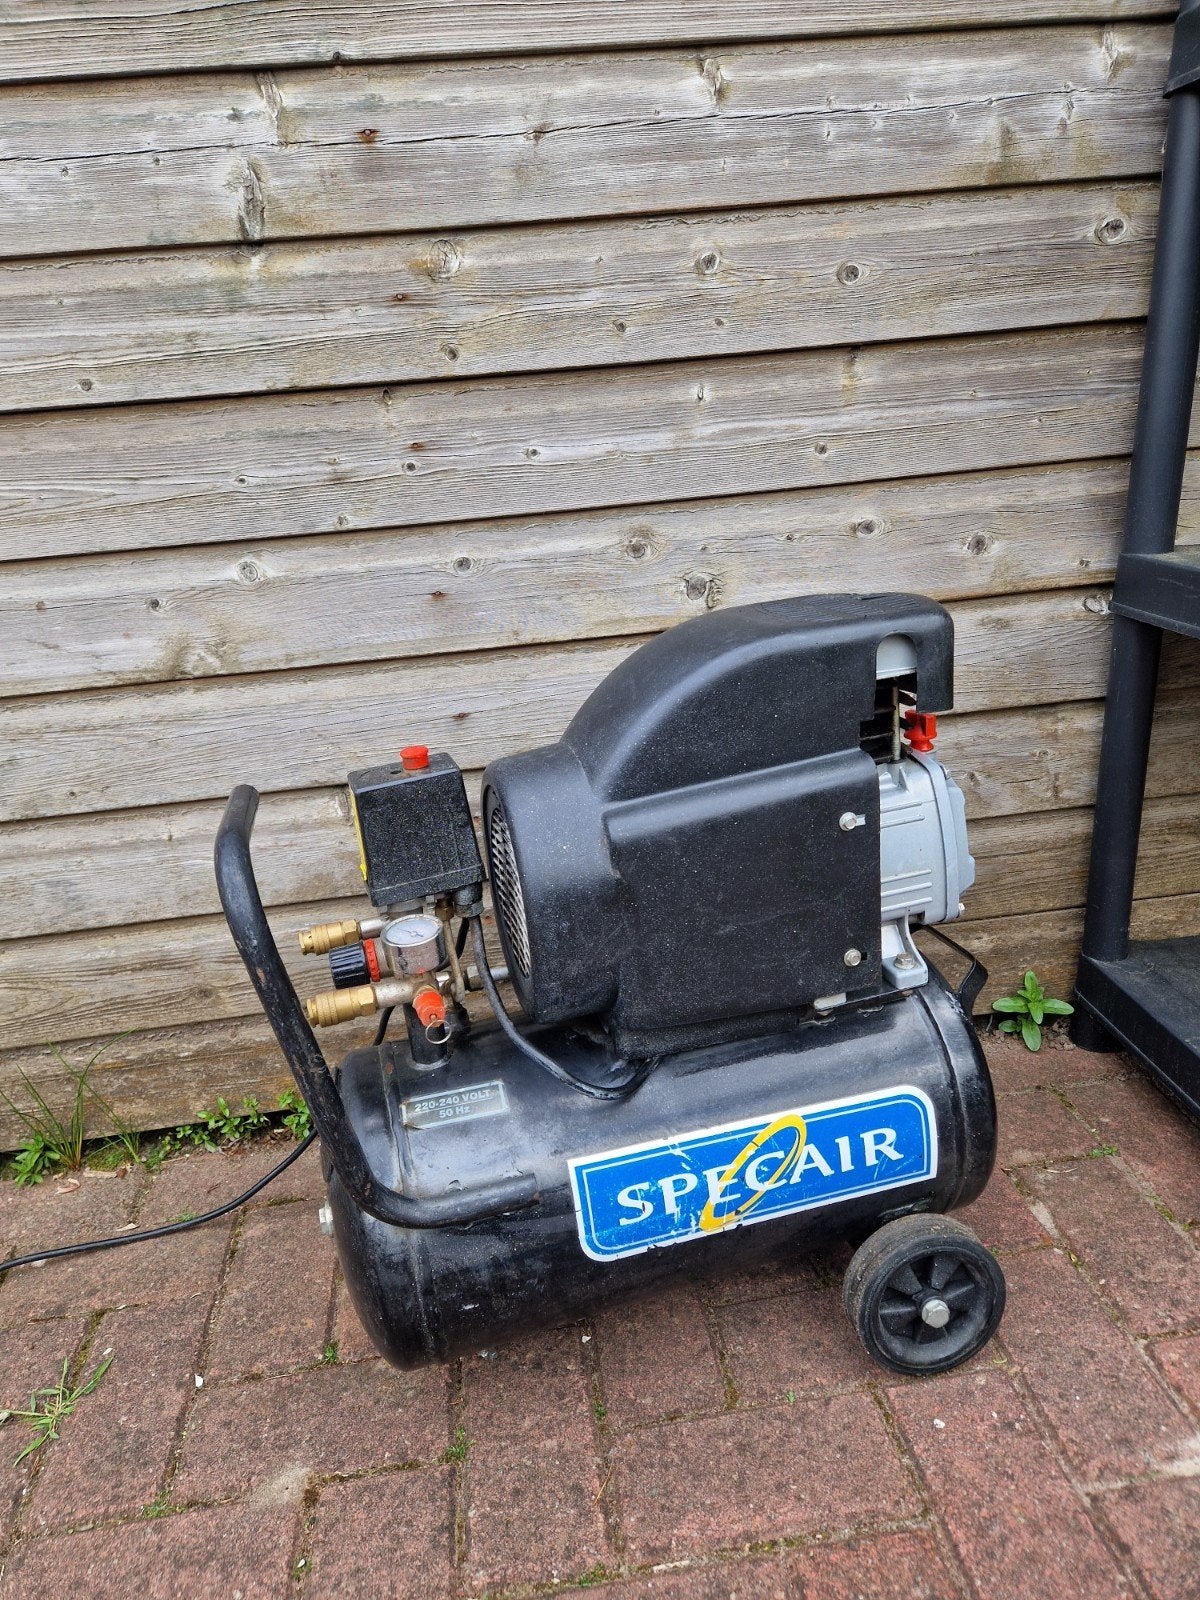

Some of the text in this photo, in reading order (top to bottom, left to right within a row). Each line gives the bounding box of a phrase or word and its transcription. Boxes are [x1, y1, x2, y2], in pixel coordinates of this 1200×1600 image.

[462, 1089, 491, 1101] VOLT
[439, 1106, 471, 1118] 50 Hz
[616, 1127, 905, 1226] SPECAIR
